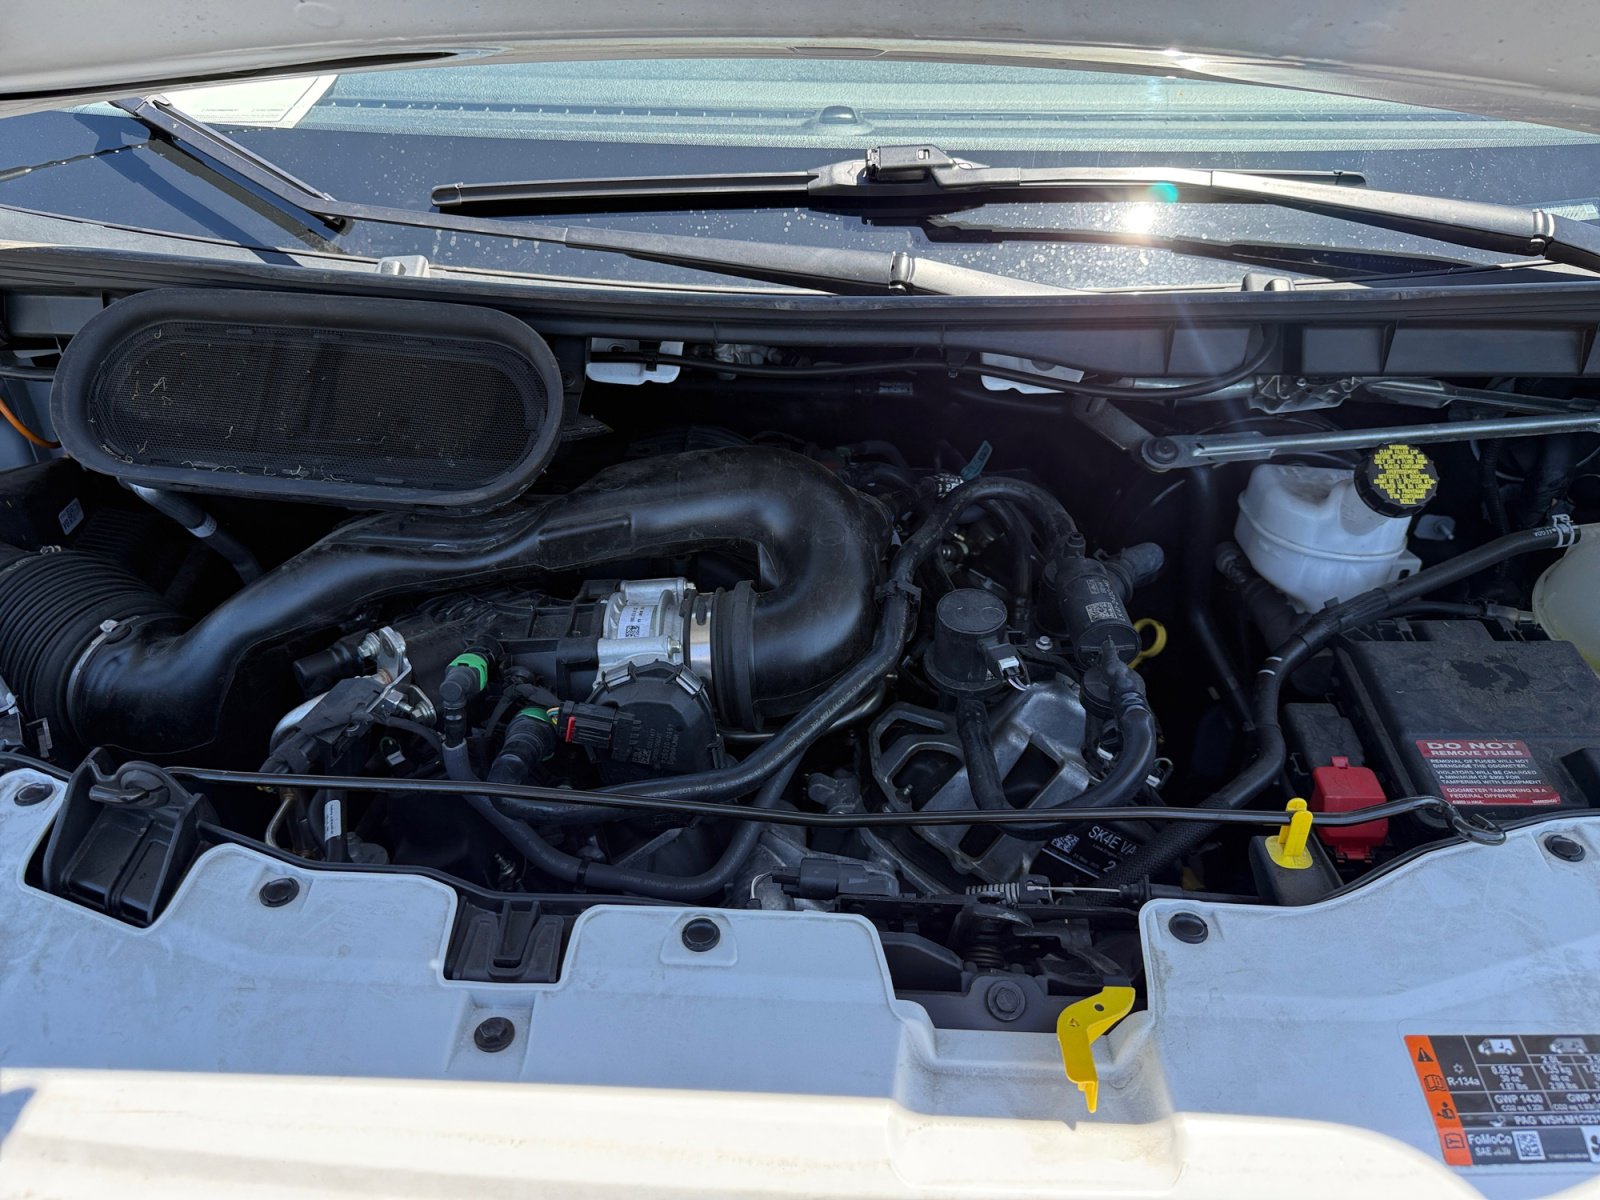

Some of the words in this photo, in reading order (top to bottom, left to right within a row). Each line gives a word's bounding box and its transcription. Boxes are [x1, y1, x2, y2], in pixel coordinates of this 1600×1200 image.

[1426, 742, 1462, 750] DO
[1468, 742, 1516, 750] NOT
[1088, 826, 1121, 849] SK4E
[1120, 841, 1137, 855] VA
[1103, 860, 1116, 873] 2
[1511, 1066, 1524, 1077] kg
[1560, 1065, 1573, 1076] kg
[1447, 1077, 1480, 1086] R-134a
[1494, 1094, 1518, 1103] GWP
[1520, 1094, 1544, 1103] 1430
[1567, 1093, 1590, 1102] GWP
[1514, 1115, 1537, 1125] PAG
[1467, 1133, 1512, 1145] FoMoCo
[1475, 1147, 1492, 1156] SAE
